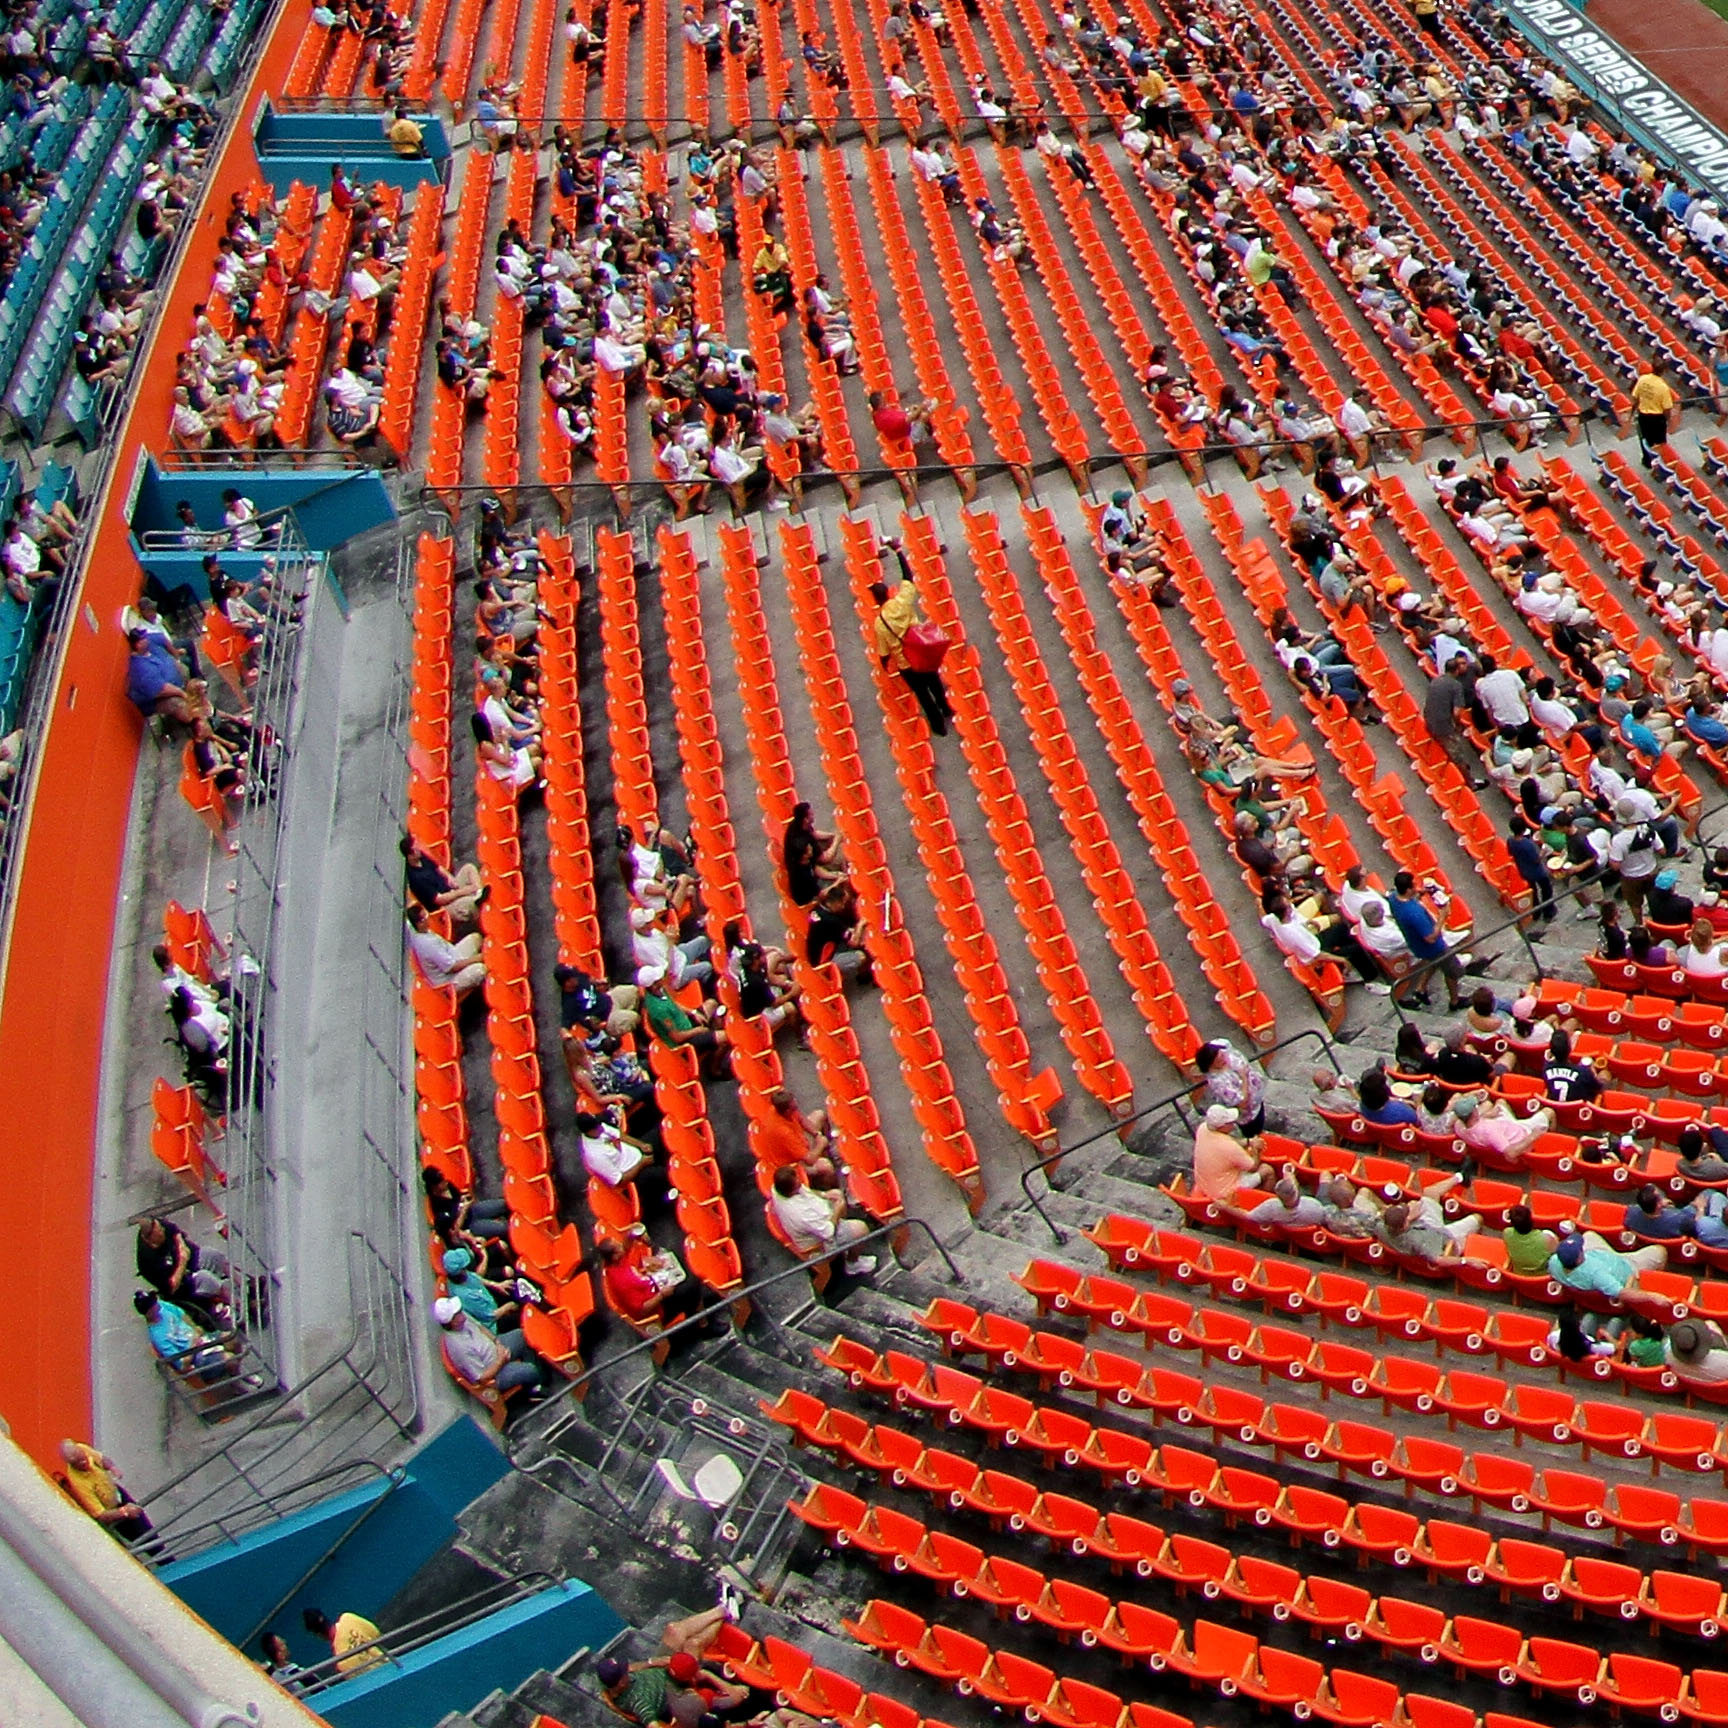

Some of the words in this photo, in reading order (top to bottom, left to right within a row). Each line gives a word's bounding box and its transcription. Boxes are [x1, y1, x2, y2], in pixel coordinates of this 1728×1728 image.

[1564, 31, 1645, 99] SERIES
[1546, 1067, 1580, 1082] MANTLE
[1553, 1081, 1570, 1102] 7
